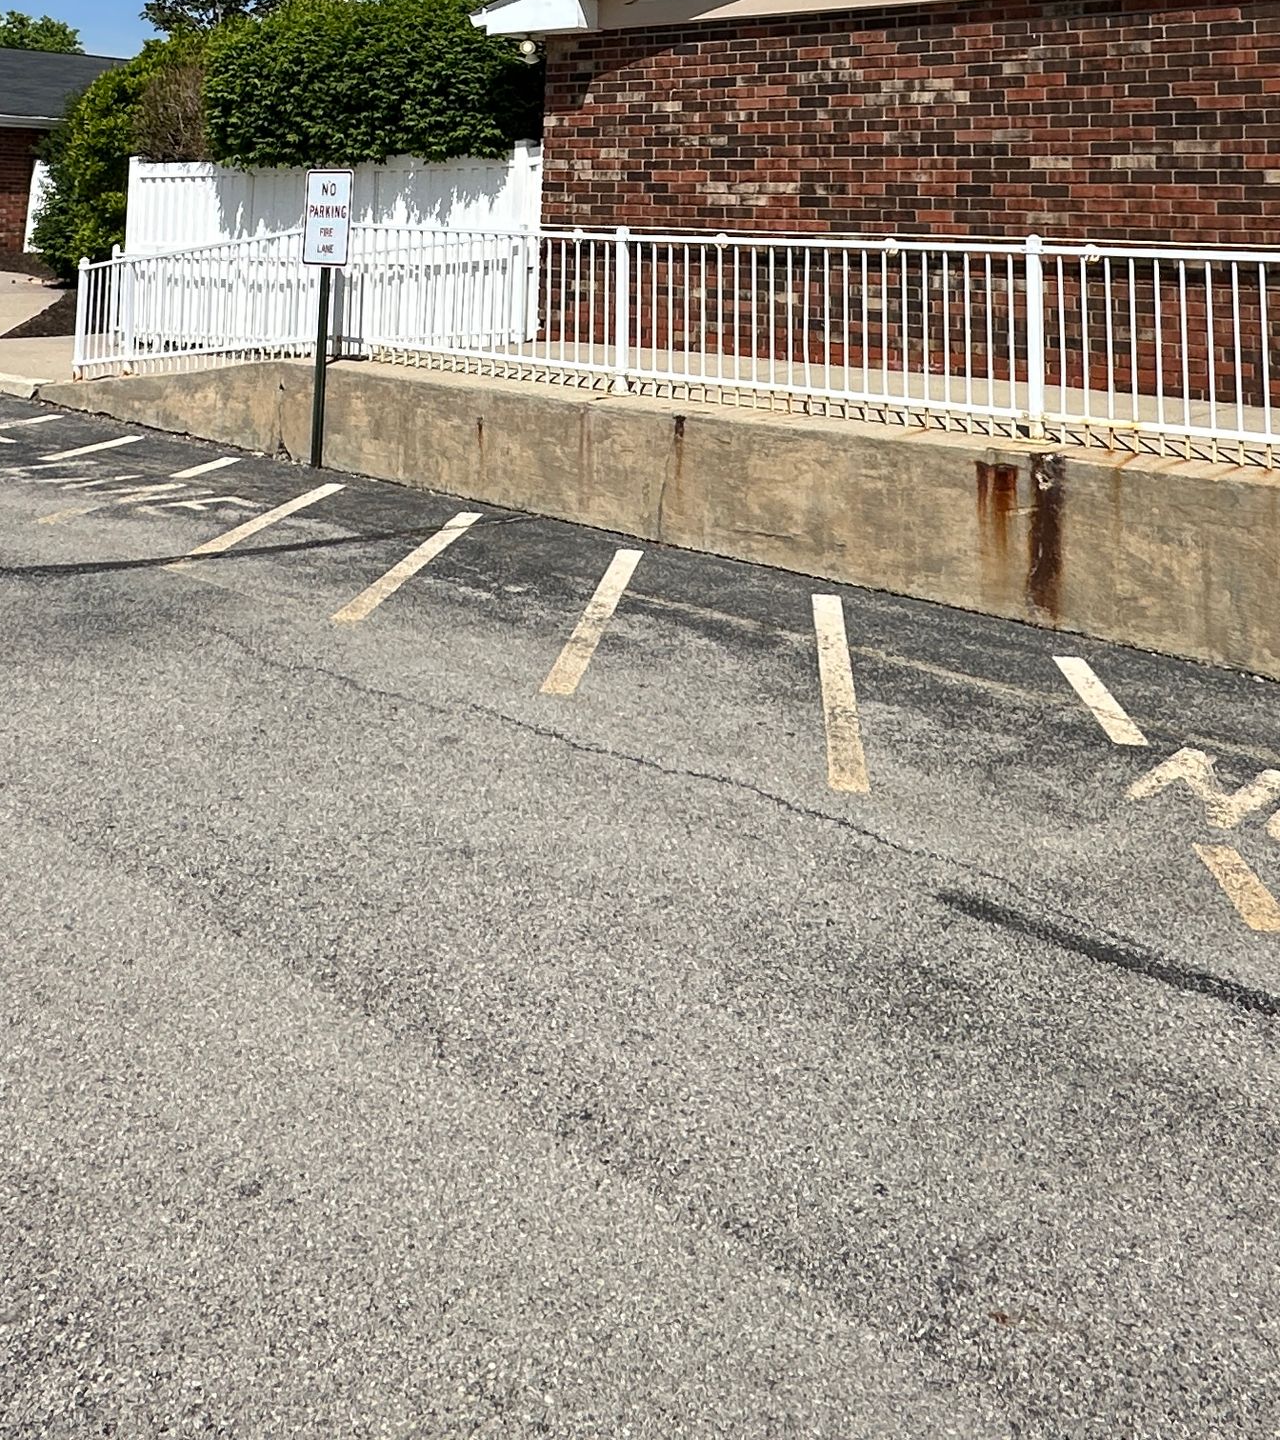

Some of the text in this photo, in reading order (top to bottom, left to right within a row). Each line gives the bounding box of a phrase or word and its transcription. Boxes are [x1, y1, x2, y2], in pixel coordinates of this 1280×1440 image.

[321, 182, 337, 196] NO
[309, 205, 347, 219] PARKING
[320, 227, 333, 237] FIRE
[317, 244, 334, 253] LANE
